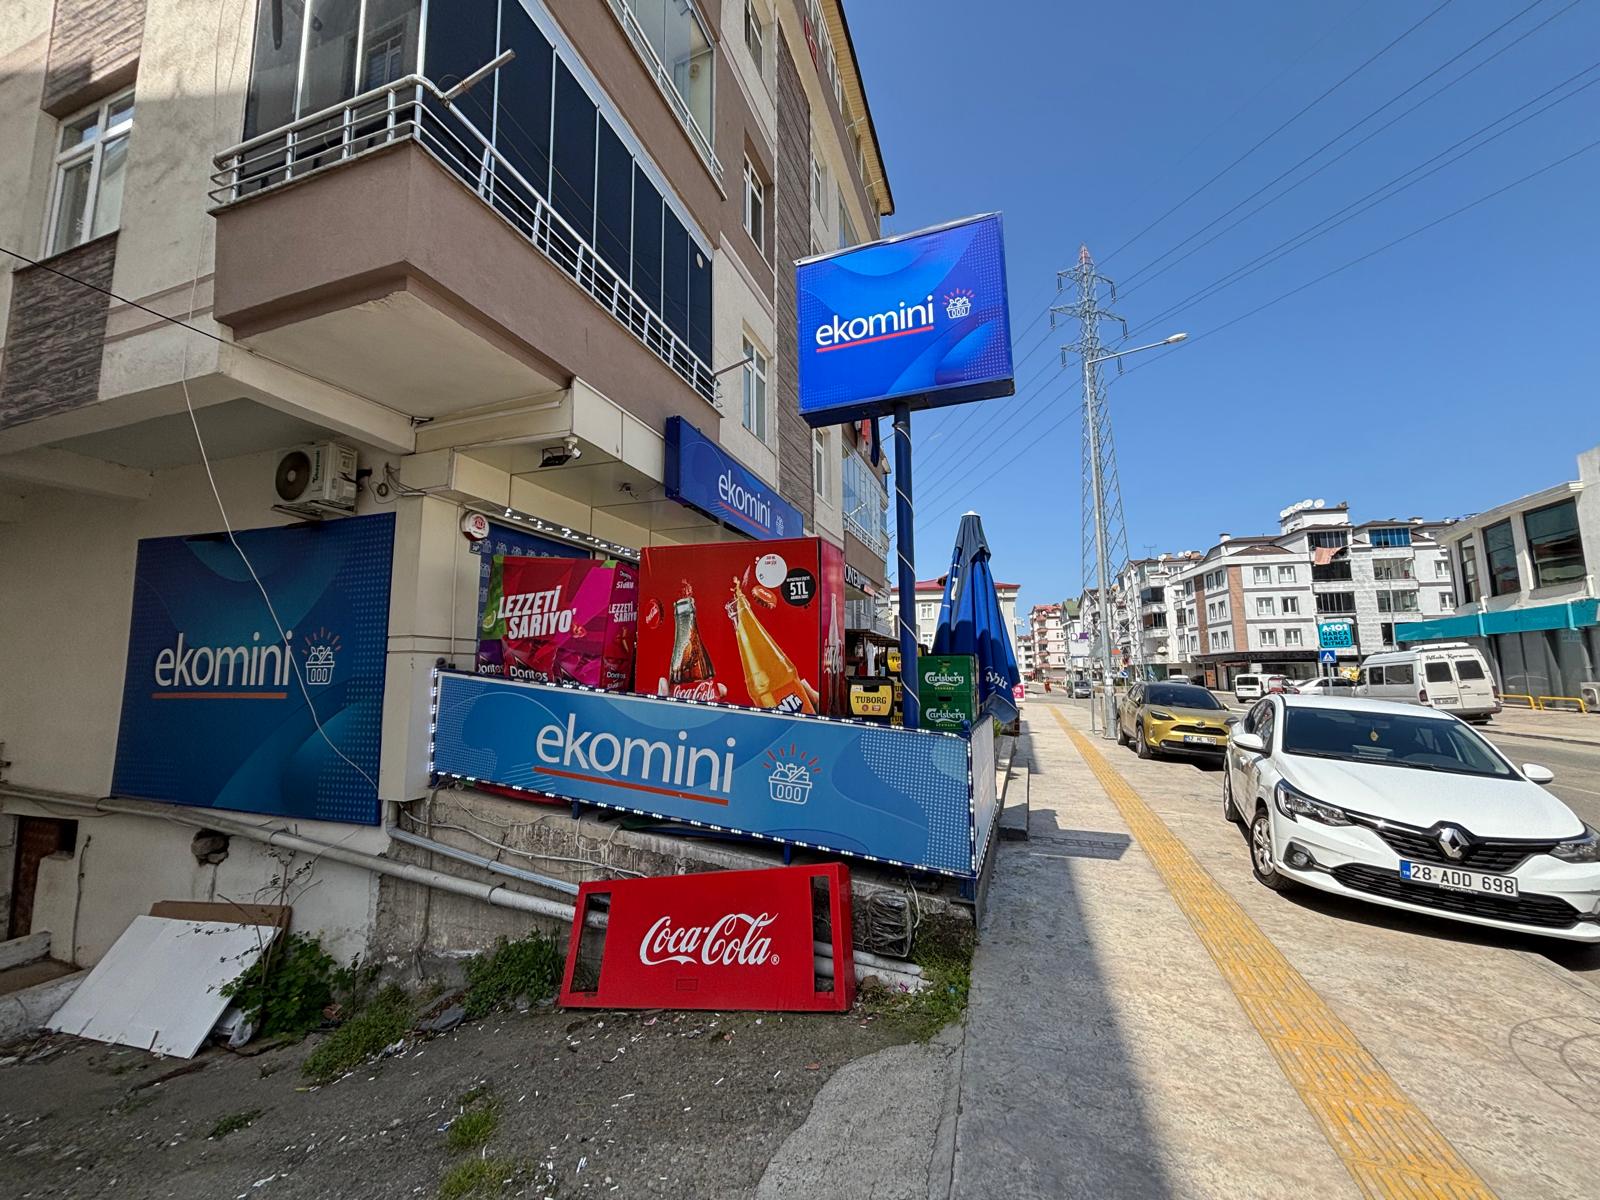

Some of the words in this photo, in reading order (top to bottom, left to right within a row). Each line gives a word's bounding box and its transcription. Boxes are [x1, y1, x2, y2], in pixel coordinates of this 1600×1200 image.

[816, 295, 934, 346] ekomini
[719, 469, 771, 529] ekomini
[496, 585, 562, 619] LEZZETİ
[790, 582, 809, 595] 5TL
[154, 629, 293, 687] ekomini
[509, 665, 549, 682] Doritos
[924, 671, 964, 686] Carlsberg
[855, 696, 887, 704] TUBORG
[925, 708, 966, 723] Carlsberg
[535, 713, 736, 793] ekomini
[1411, 865, 1432, 881] 28
[1440, 870, 1472, 887] ADD
[1482, 876, 1514, 894] 698
[639, 912, 779, 966] Coca-Cola
